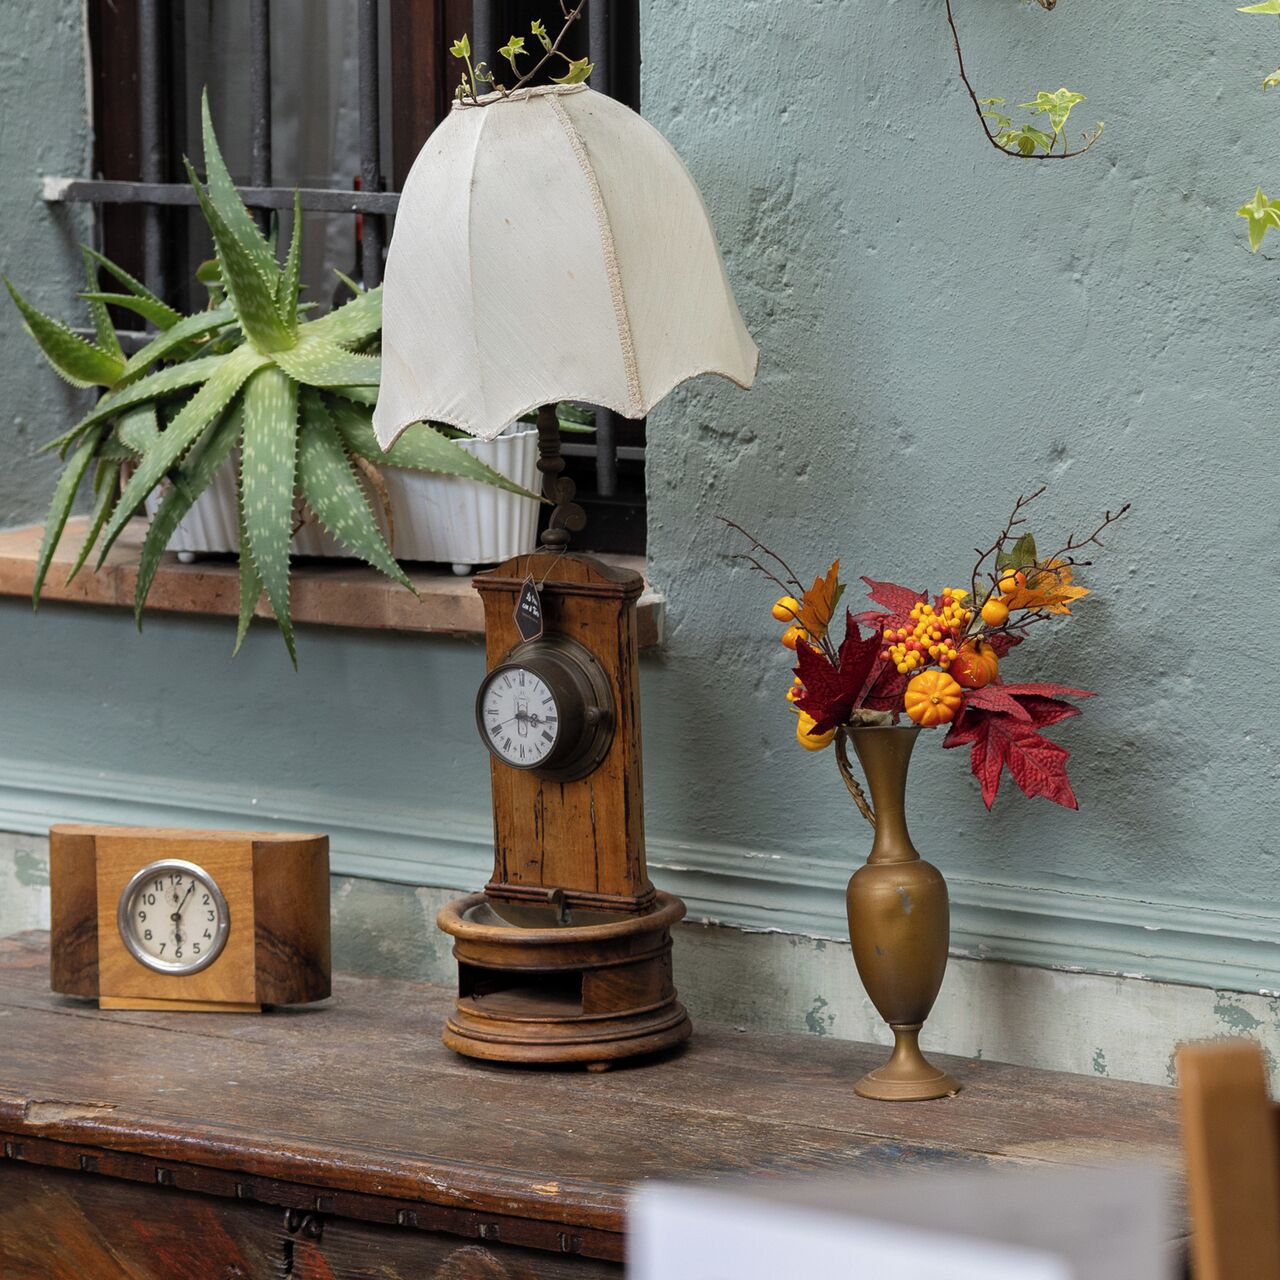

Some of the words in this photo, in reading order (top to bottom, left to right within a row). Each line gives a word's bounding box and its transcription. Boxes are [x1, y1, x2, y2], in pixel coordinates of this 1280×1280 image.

[169, 874, 183, 885] 12
[154, 880, 163, 891] 11
[142, 894, 156, 905] 10
[202, 894, 210, 905] 2
[138, 911, 146, 923] 9
[207, 910, 215, 922] 3
[144, 929, 153, 940] 8
[203, 929, 212, 940] 4
[159, 943, 167, 954] 7
[175, 946, 183, 958] 6
[192, 943, 201, 954] 5
